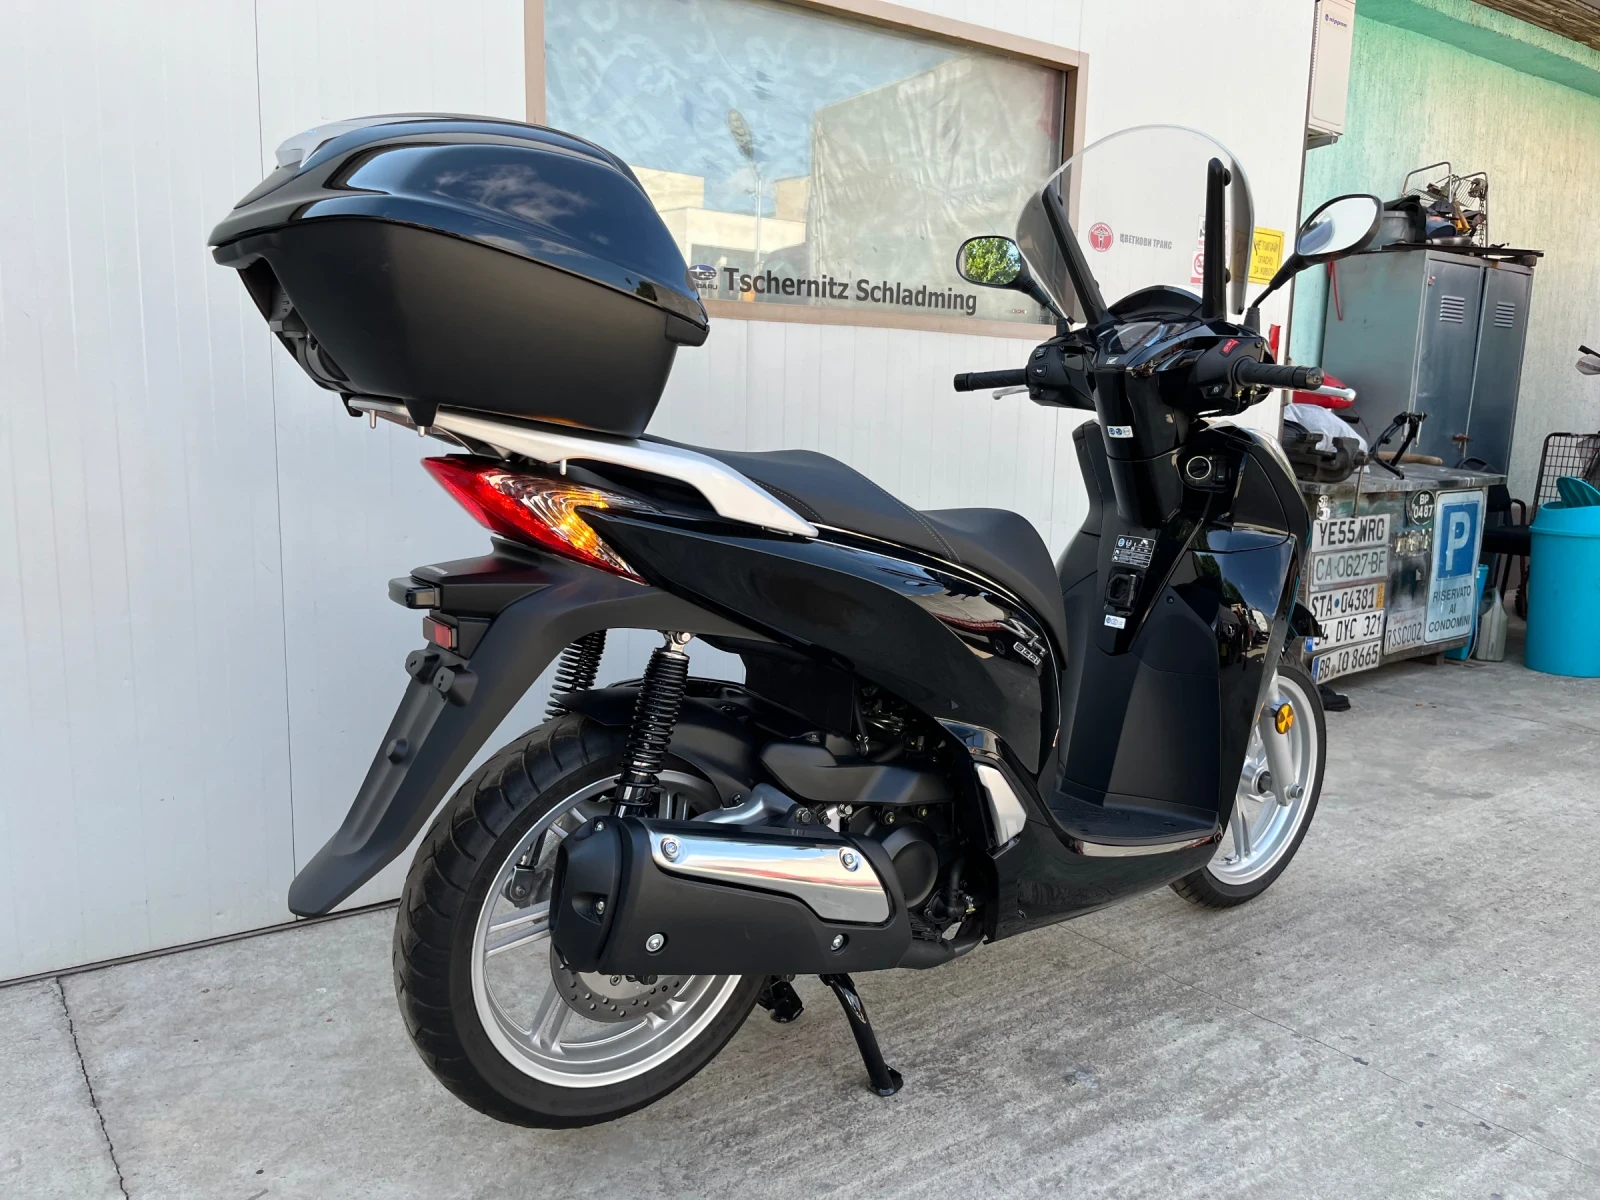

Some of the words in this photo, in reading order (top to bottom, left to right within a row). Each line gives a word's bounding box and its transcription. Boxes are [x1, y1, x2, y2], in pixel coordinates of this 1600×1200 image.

[1119, 233, 1152, 248] ЦВЕТКОВИ
[1153, 239, 1173, 250] ТРАНС
[723, 267, 849, 300] Tschernitz
[856, 279, 977, 316] Schladming
[1419, 493, 1430, 504] BP
[1413, 505, 1433, 519] 0487
[1319, 520, 1356, 546] YE55
[1445, 511, 1471, 571] P
[1432, 585, 1472, 603] RISERVATO
[1448, 605, 1456, 615] AI
[1336, 618, 1357, 643] DYC
[1363, 613, 1382, 637] 321
[1428, 615, 1471, 633] CONDOMINI
[1351, 643, 1379, 669] 8665
